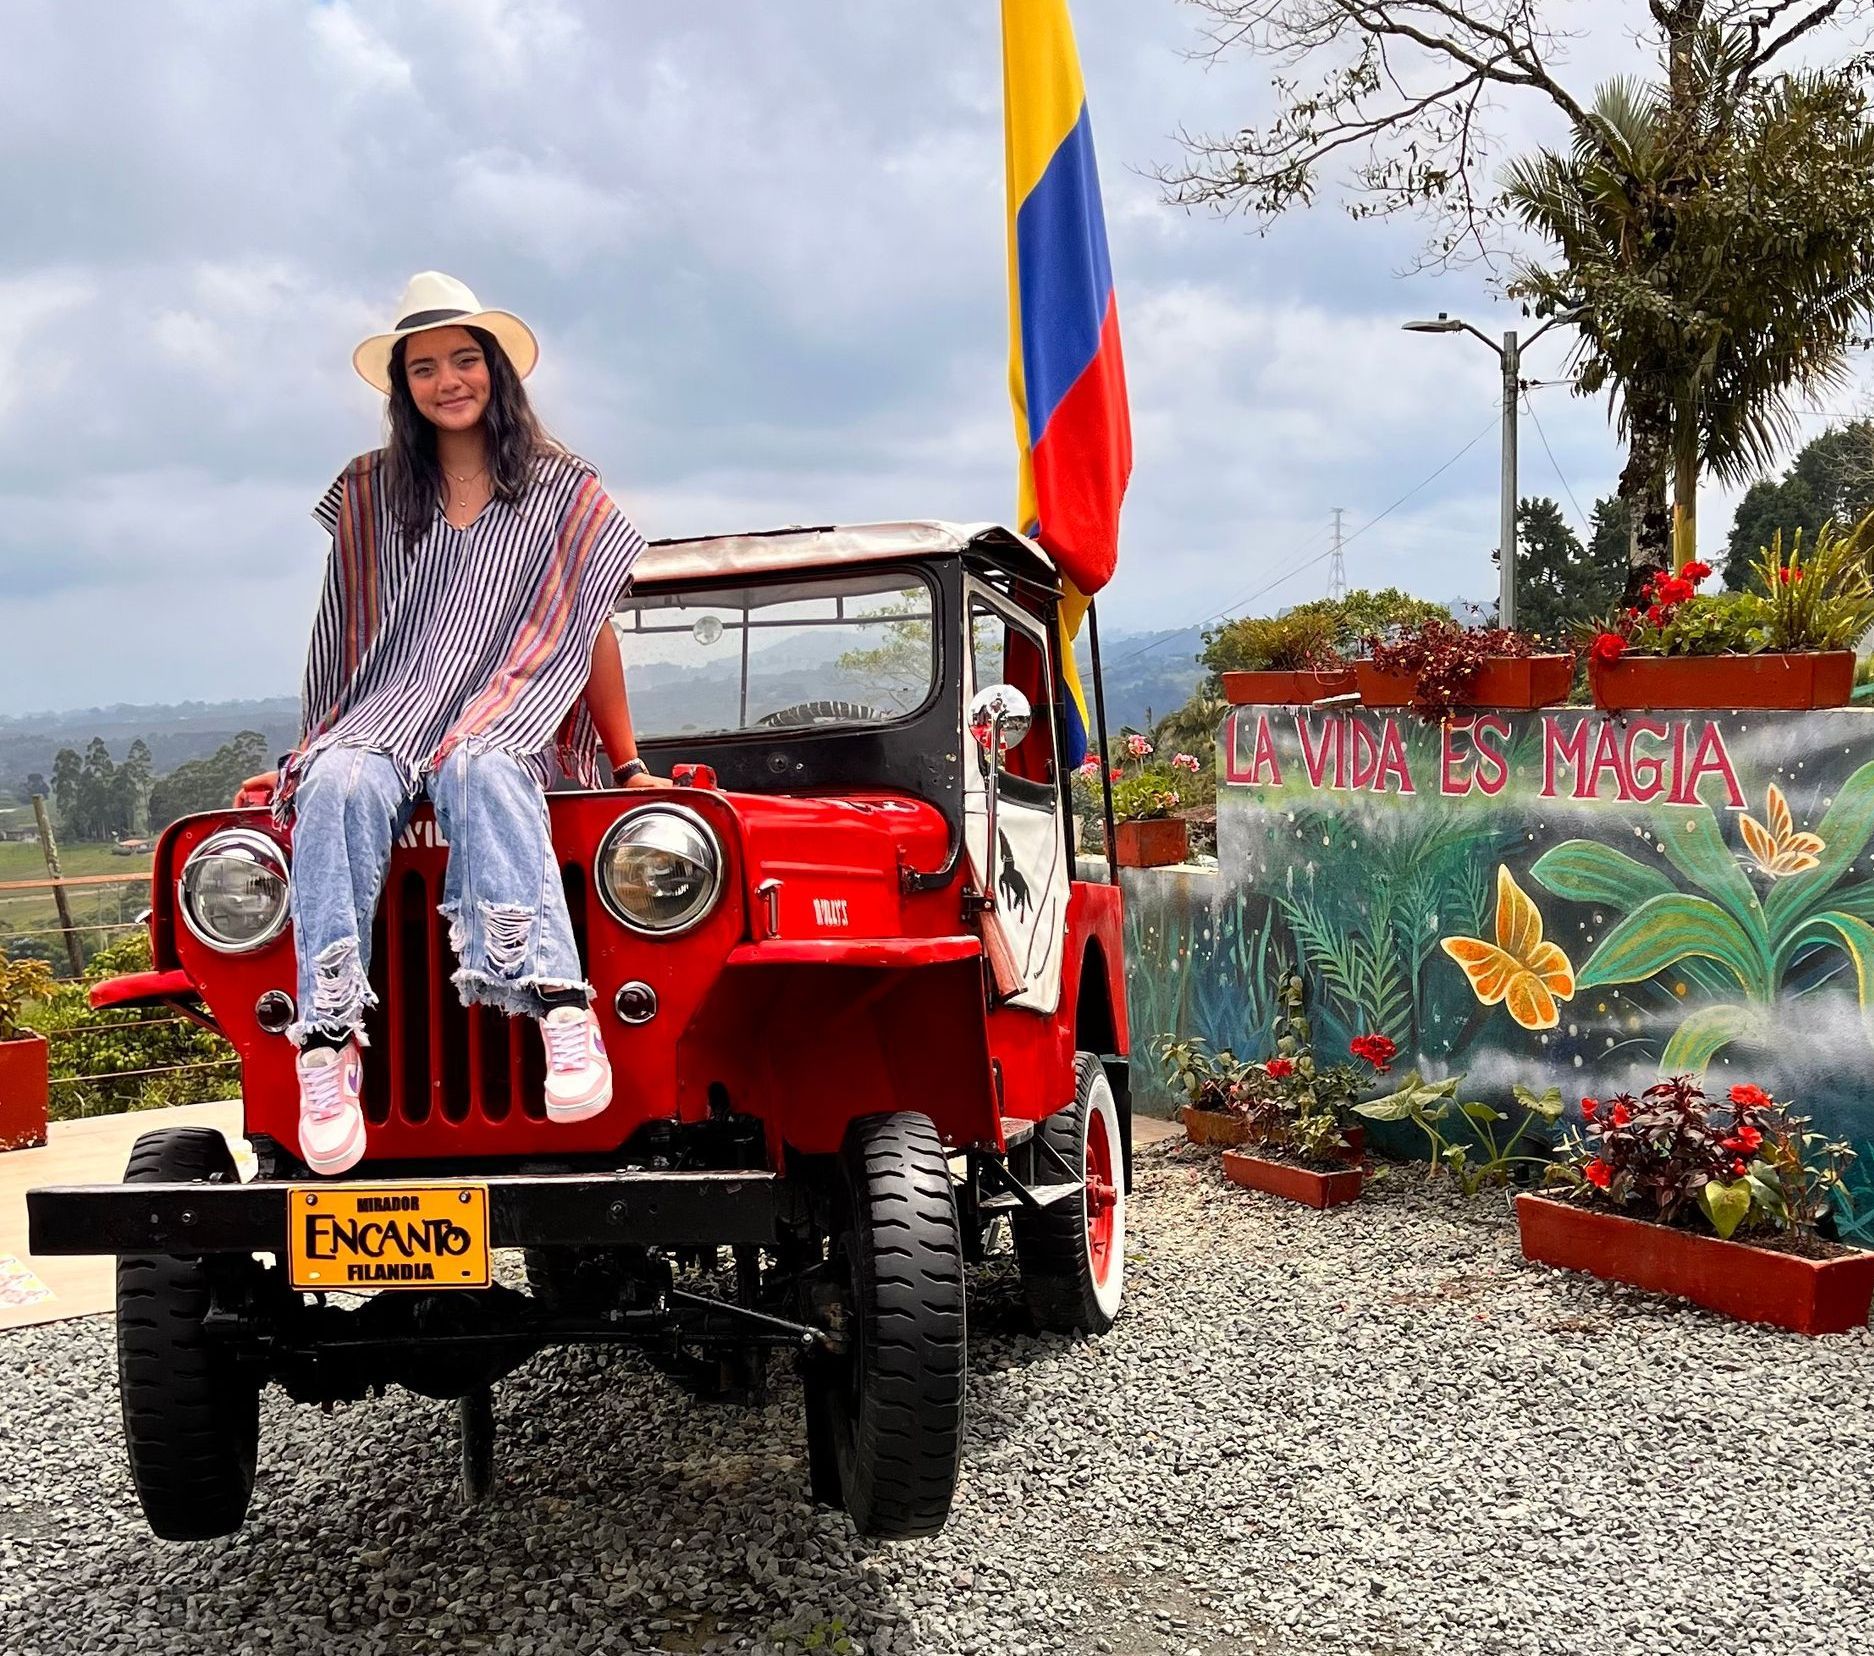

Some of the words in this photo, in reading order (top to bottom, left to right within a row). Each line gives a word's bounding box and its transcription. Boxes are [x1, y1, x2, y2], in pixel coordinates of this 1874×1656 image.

[1225, 712, 1283, 788] LA
[1295, 714, 1417, 796] VIDA
[1440, 711, 1512, 798] ES
[1539, 715, 1749, 811] MAGIA
[356, 1196, 420, 1213] MIRADOR
[305, 1214, 472, 1260] ENCANTO
[347, 1263, 435, 1281] FILANDIA
